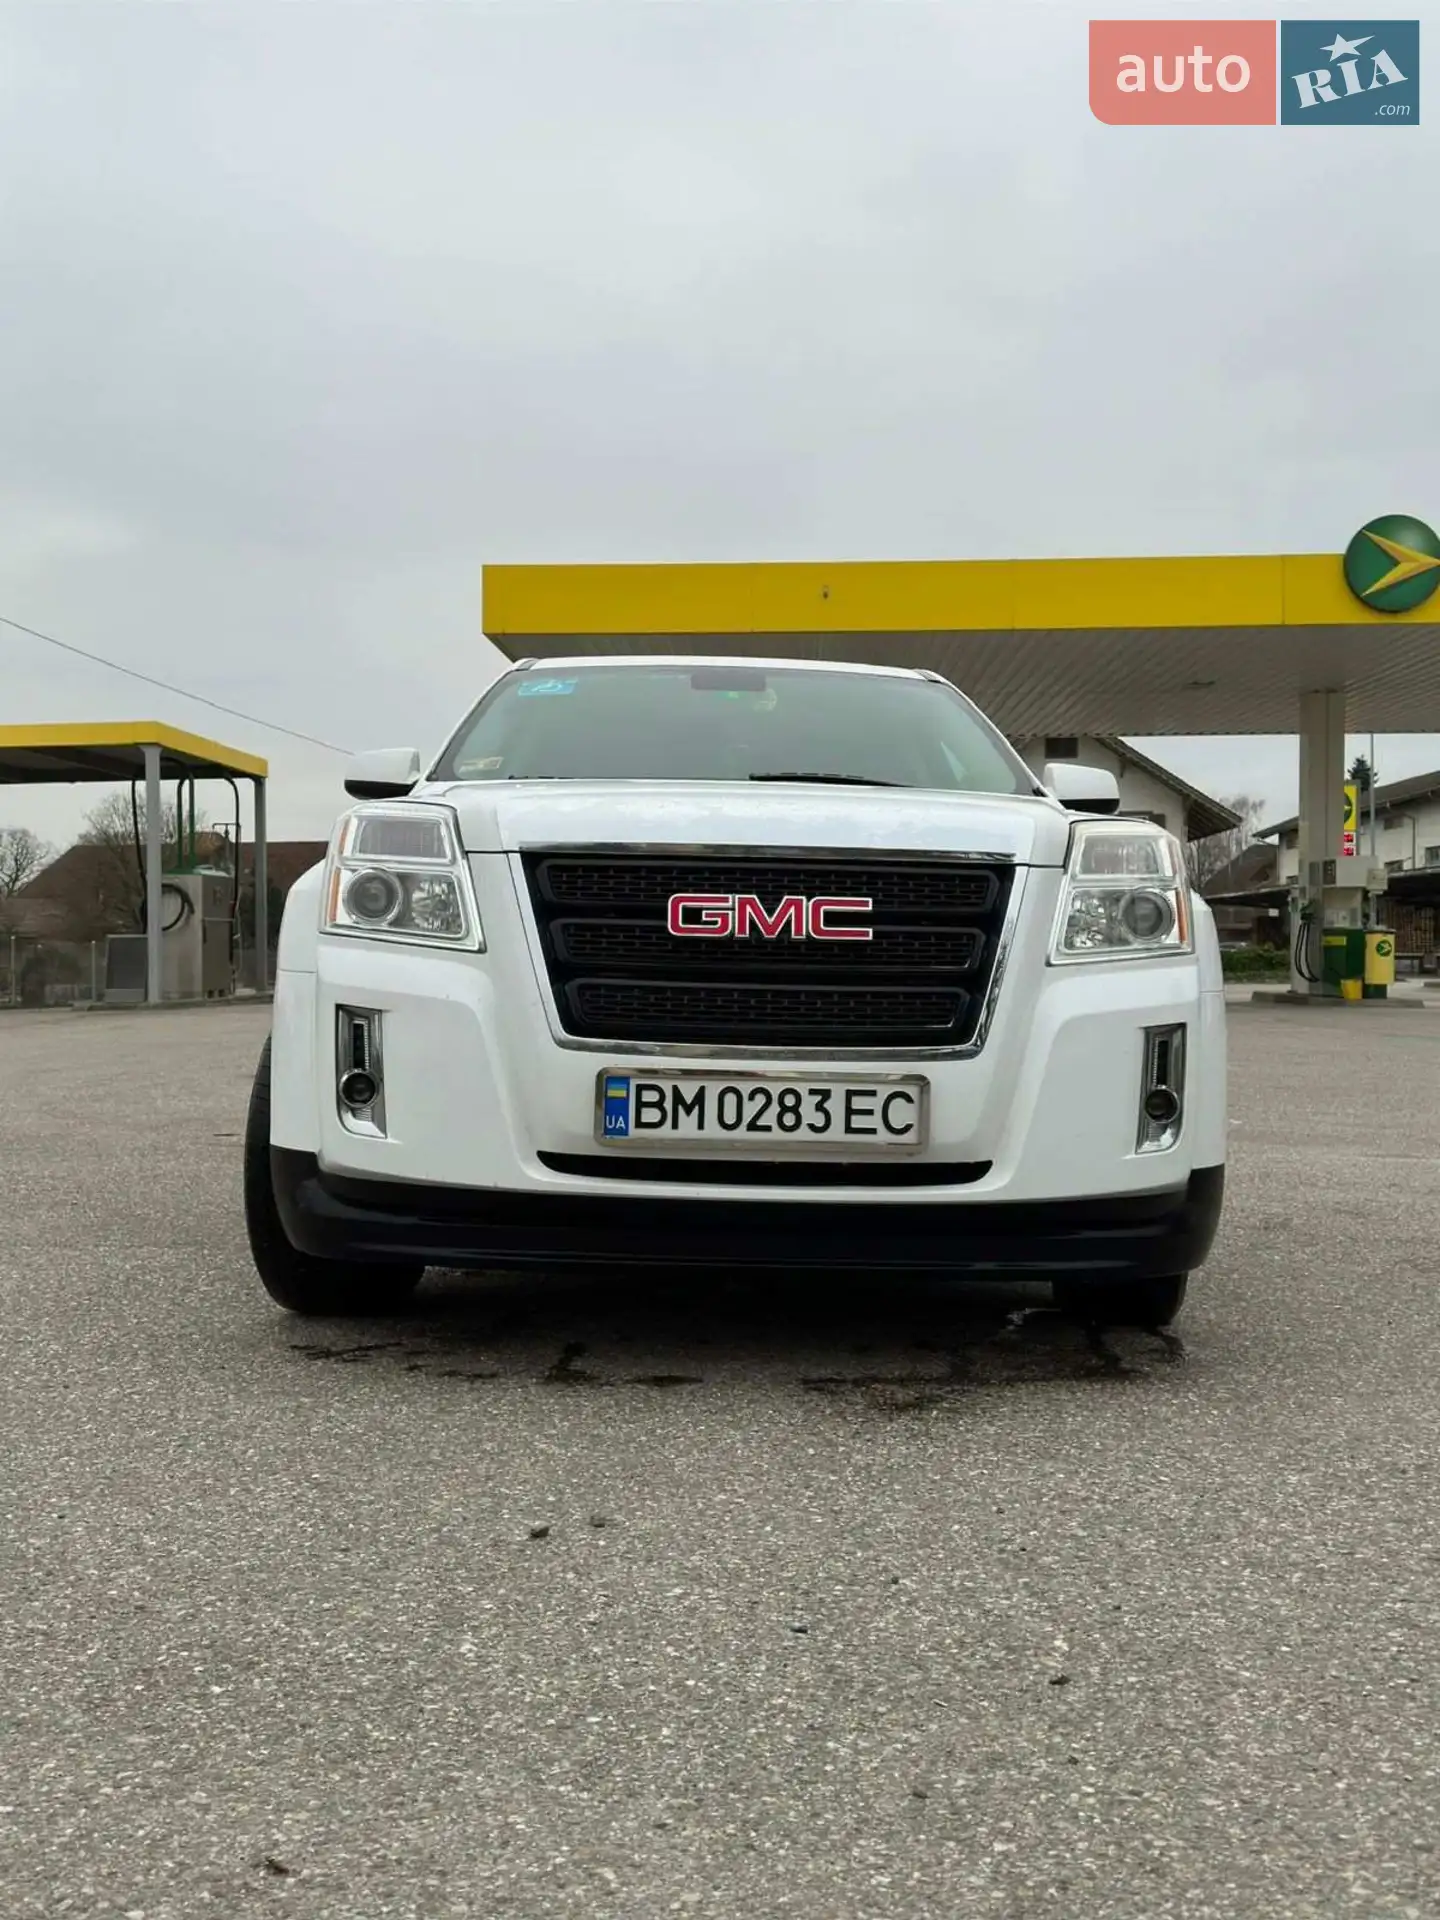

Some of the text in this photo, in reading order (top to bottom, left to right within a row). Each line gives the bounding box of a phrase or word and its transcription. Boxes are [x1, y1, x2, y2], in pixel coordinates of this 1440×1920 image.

[667, 893, 873, 940] GMC
[606, 1115, 627, 1129] UA
[634, 1083, 915, 1135] BM 0283 EC
